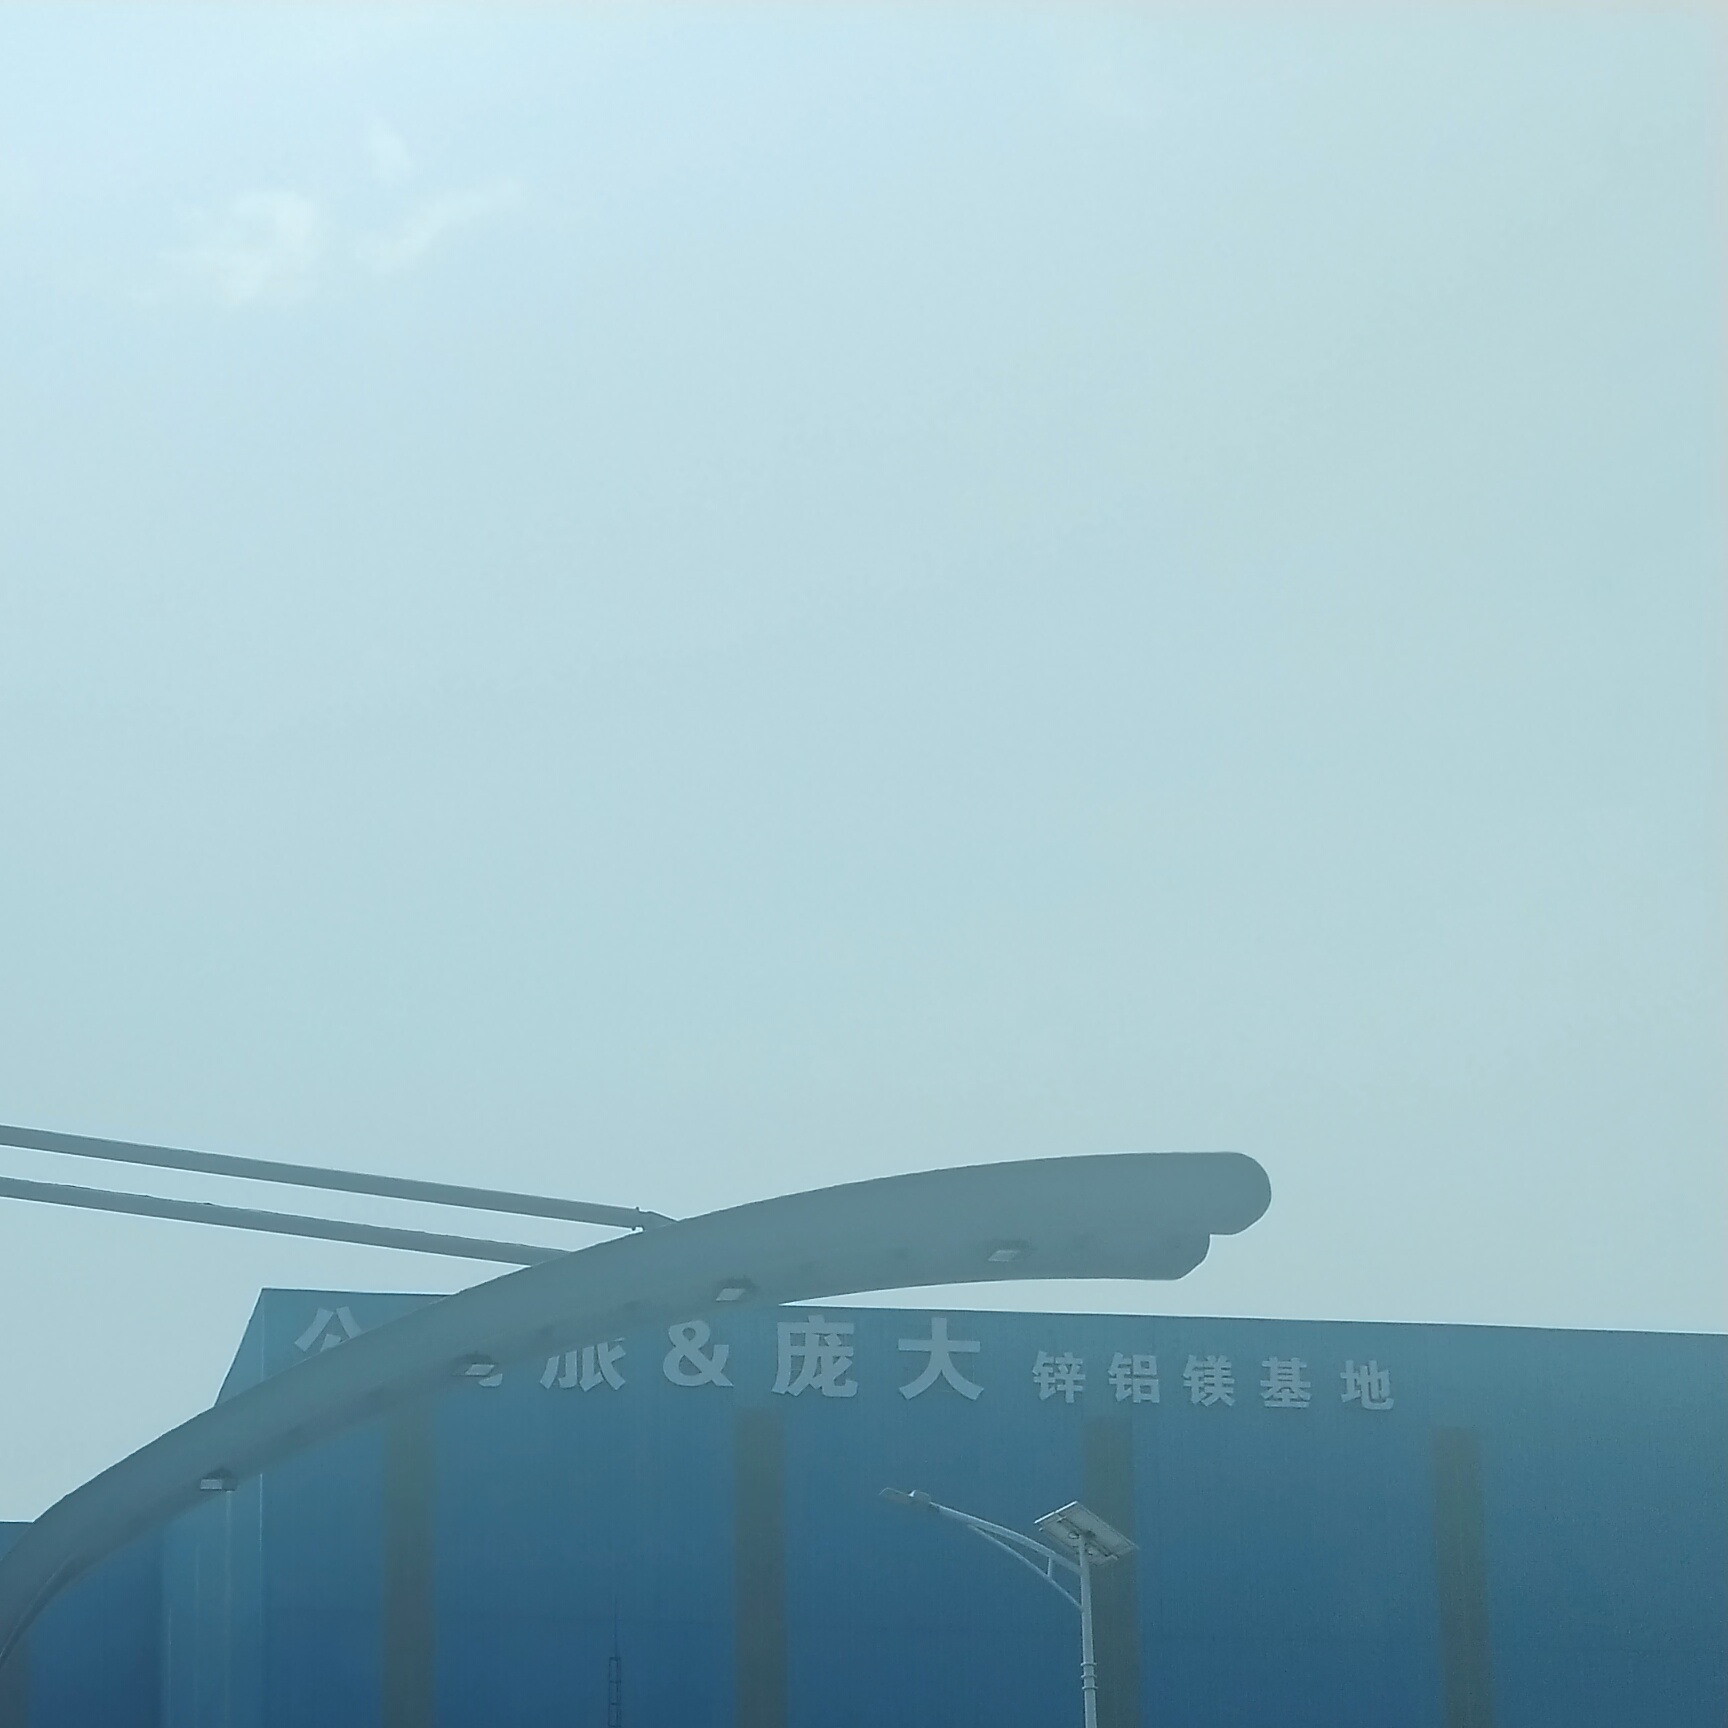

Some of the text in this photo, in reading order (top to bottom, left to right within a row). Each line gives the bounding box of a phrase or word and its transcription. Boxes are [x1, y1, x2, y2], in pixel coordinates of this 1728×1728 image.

[1032, 1349, 1395, 1413] 锌铝镁基地
